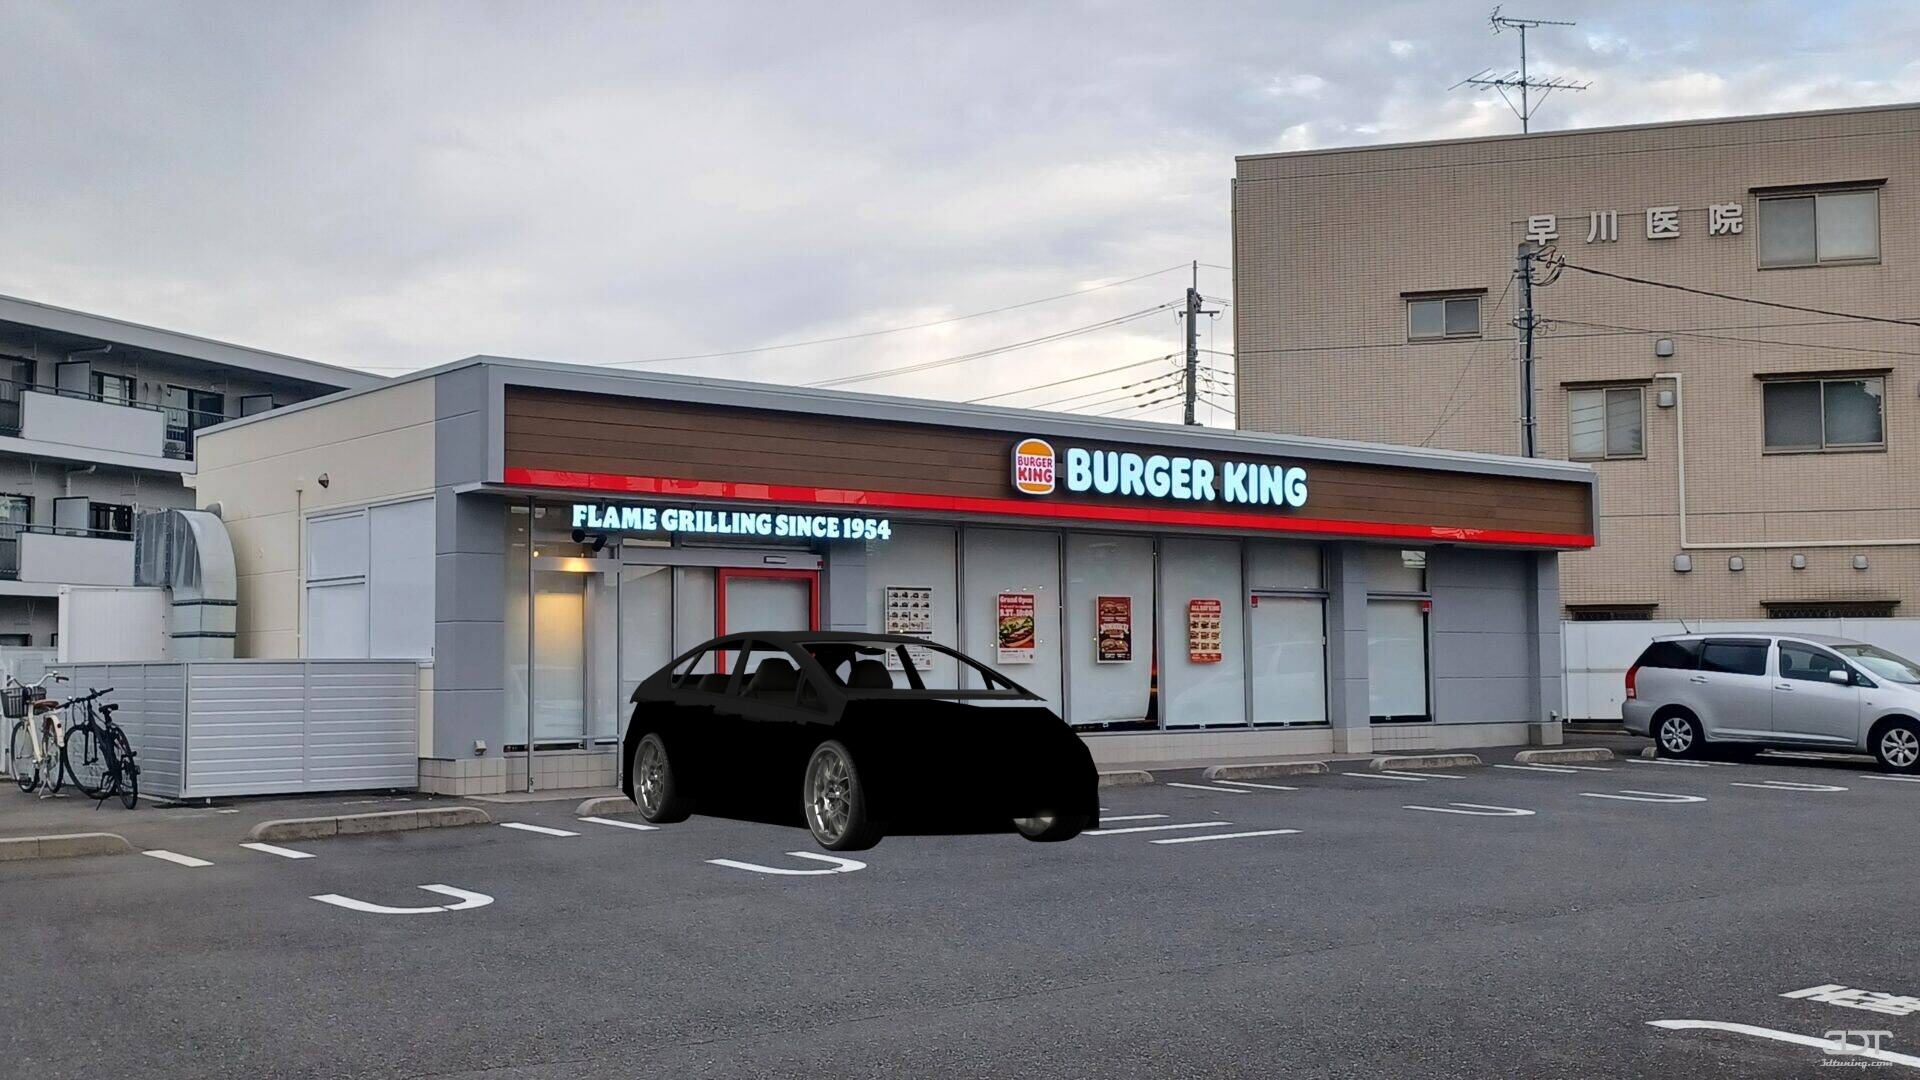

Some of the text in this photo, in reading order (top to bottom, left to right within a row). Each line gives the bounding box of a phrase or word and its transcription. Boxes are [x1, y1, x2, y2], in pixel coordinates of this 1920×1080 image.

[1525, 202, 1743, 245] 早川医院
[1017, 456, 1053, 468] BURGER
[1018, 467, 1053, 482] KING
[1066, 448, 1308, 507] BURGER KING
[572, 505, 891, 540] FLAME GRILLING SINCE 1954
